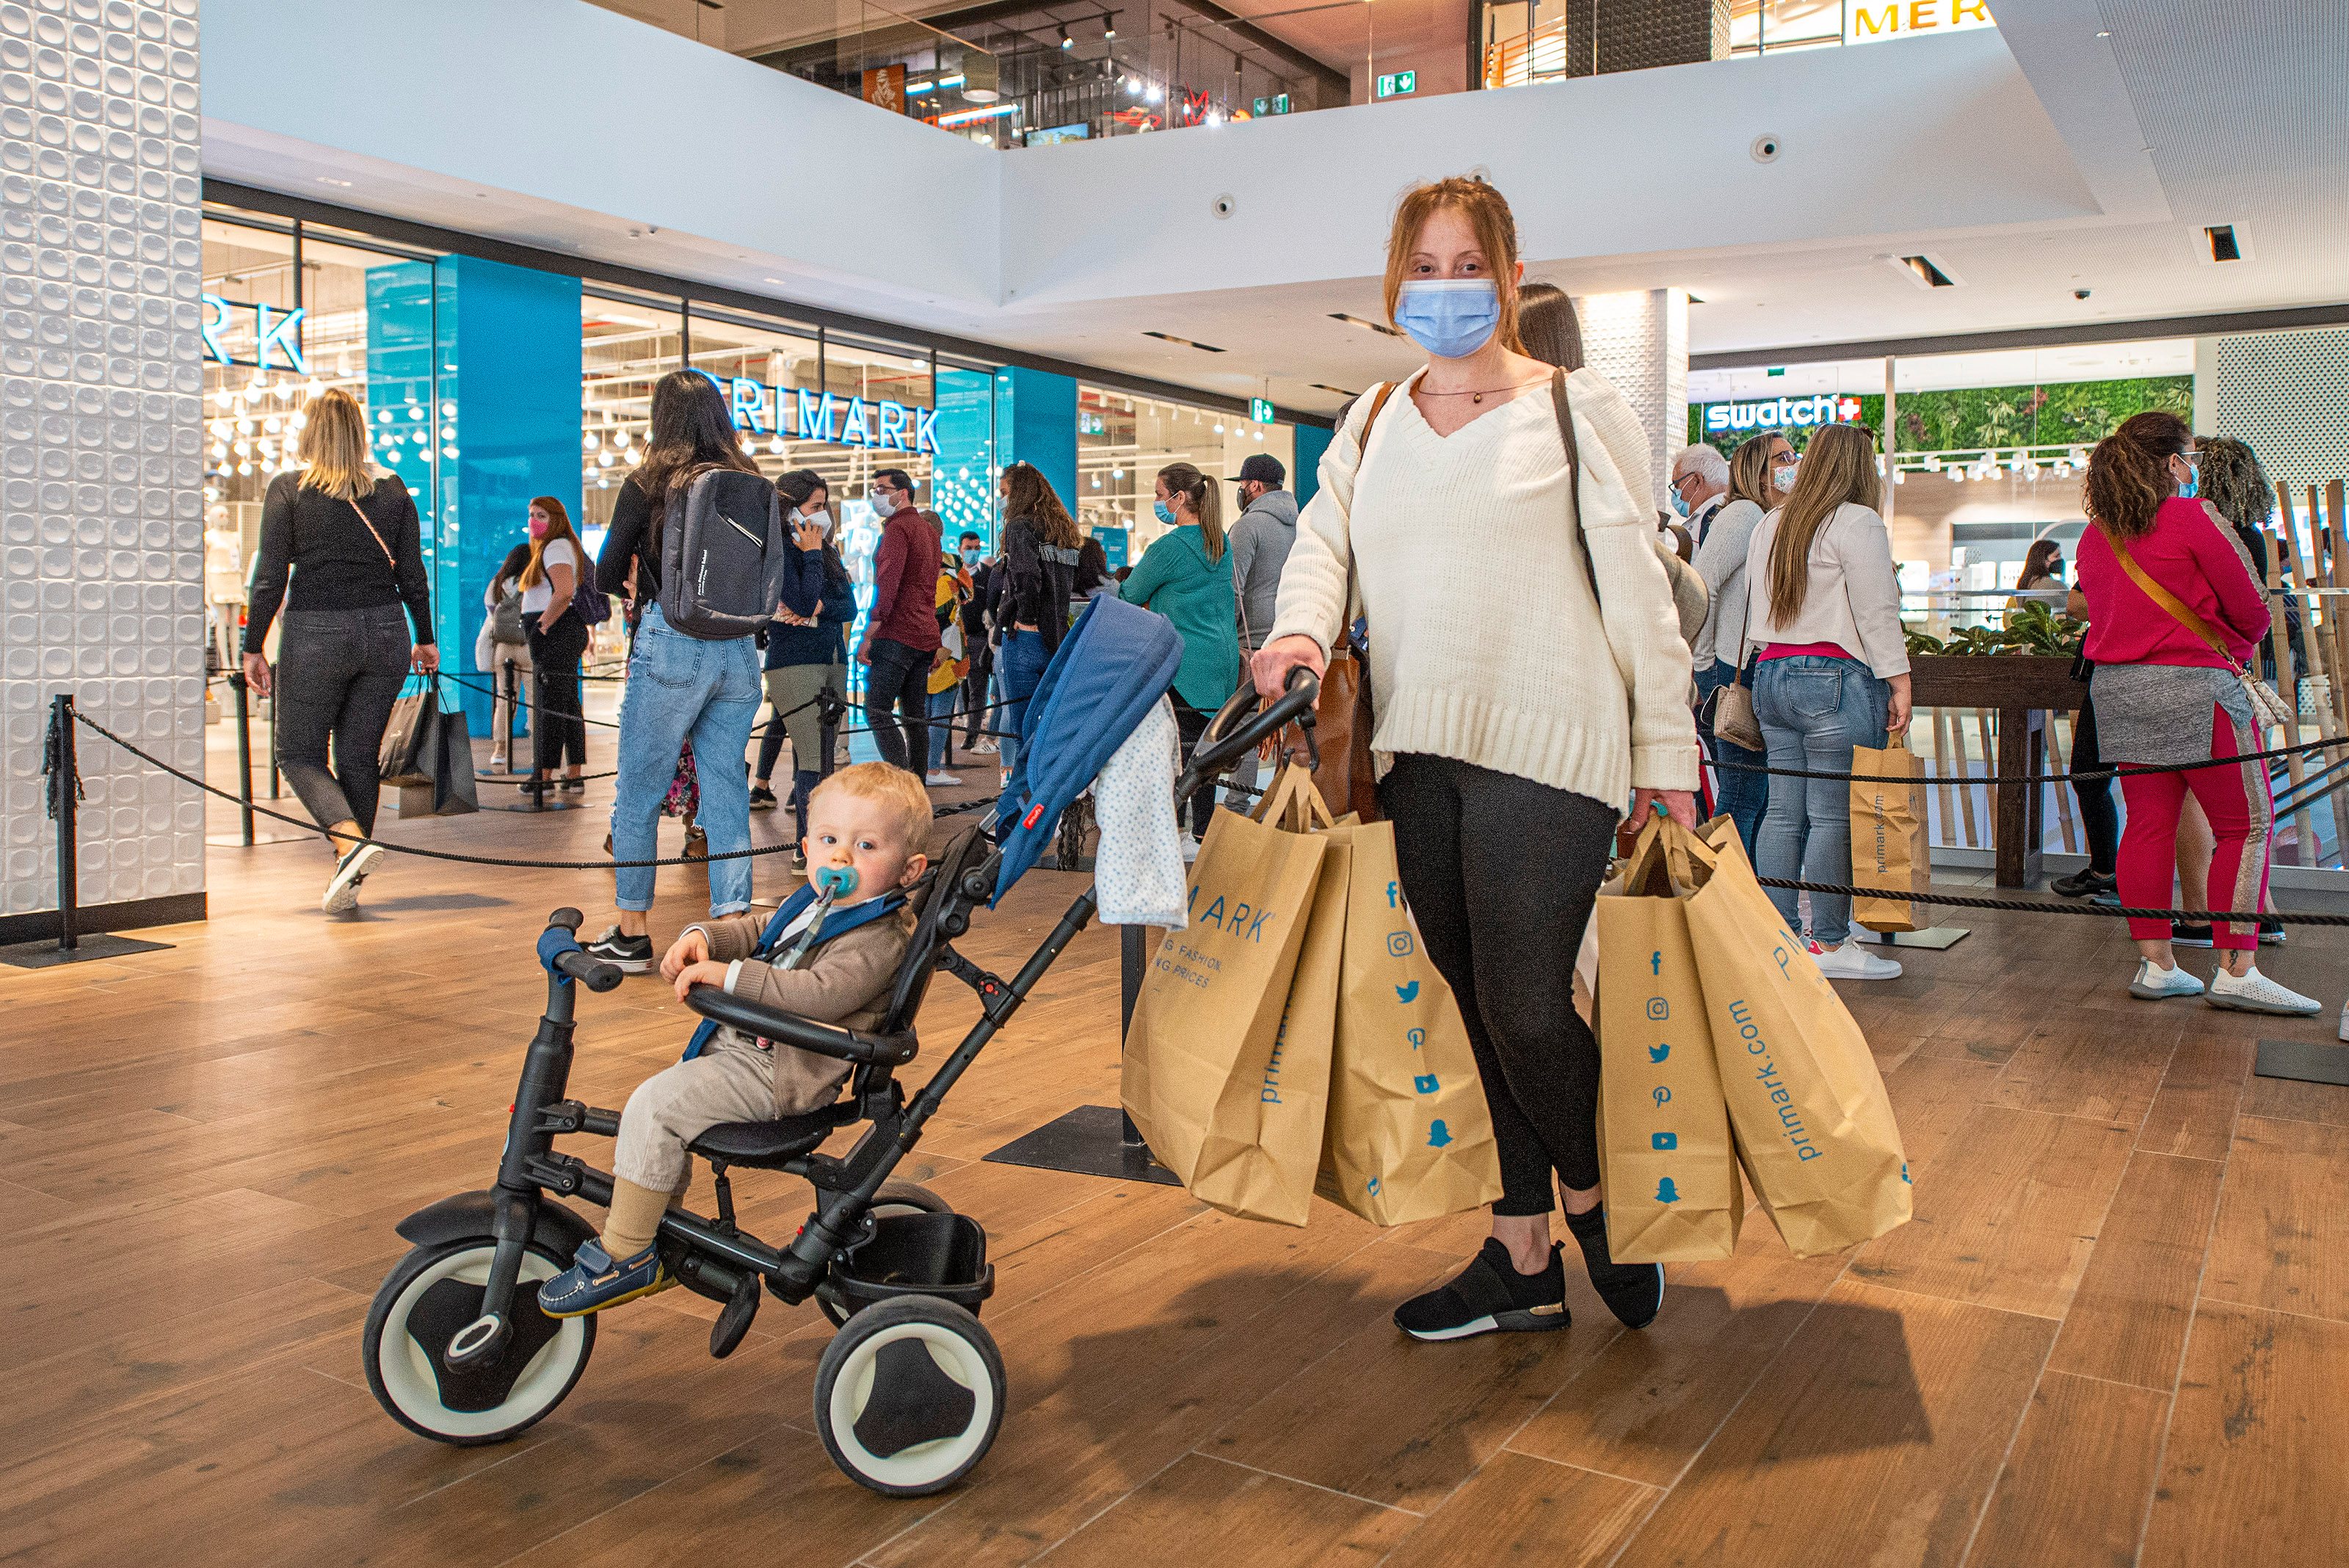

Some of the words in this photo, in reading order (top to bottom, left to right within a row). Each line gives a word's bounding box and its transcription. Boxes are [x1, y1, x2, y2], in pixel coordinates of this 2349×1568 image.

[1856, 0, 1986, 36] MER
[689, 368, 942, 454] RIMARK
[1707, 394, 1837, 430] swatch
[1874, 794, 1889, 874] primarkcom
[1728, 999, 1823, 1162] primark.com
